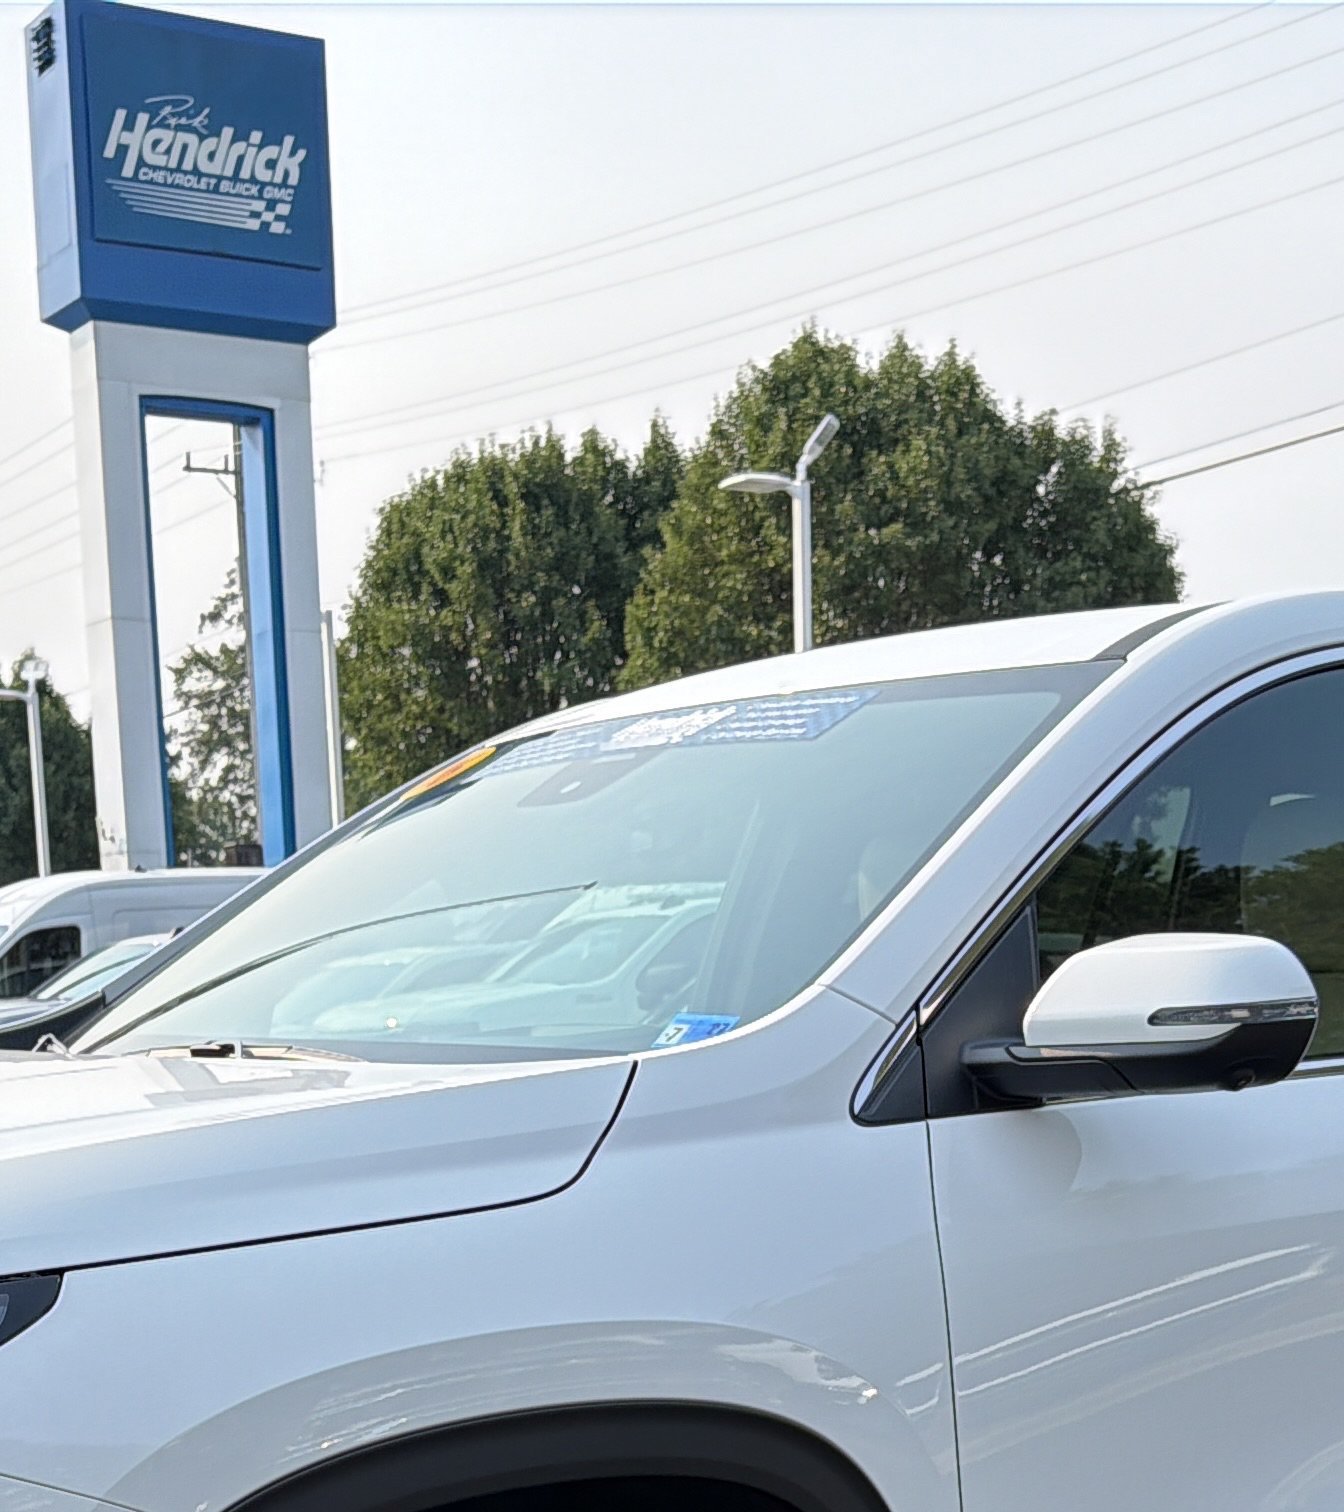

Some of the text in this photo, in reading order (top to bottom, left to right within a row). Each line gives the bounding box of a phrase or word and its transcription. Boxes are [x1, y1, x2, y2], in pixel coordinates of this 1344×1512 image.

[102, 107, 307, 186] Hendrick
[137, 166, 295, 201] CHEVROLET BUICK GMC
